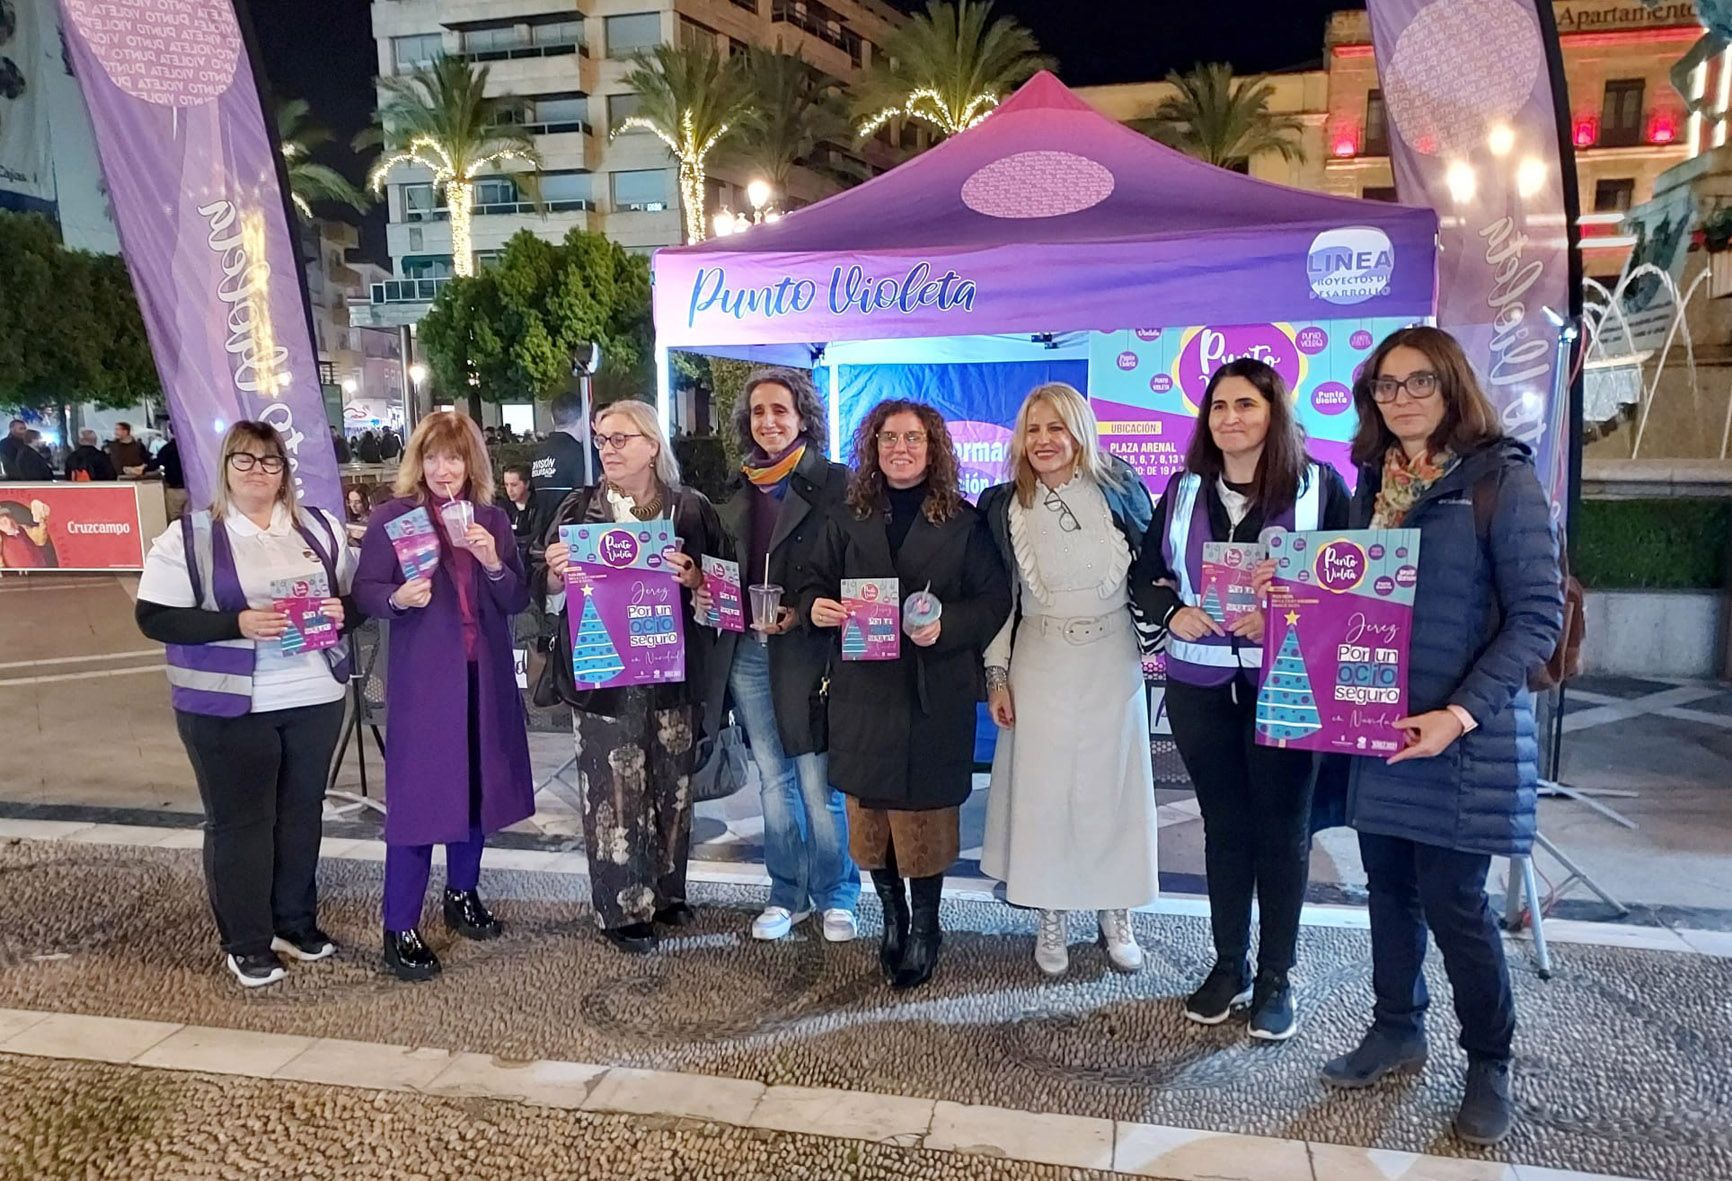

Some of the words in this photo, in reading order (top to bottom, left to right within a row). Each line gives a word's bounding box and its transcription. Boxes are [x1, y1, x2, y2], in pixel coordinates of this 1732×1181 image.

[1308, 250, 1392, 273] LINEA
[688, 266, 816, 328] Punto
[827, 261, 977, 313] Violeta
[1110, 442, 1138, 453] PLAZA
[1141, 442, 1177, 453] ARENAL
[1146, 466, 1158, 476] DE
[1160, 466, 1170, 476] 19
[67, 521, 131, 535] Cruzcampo
[605, 534, 632, 551] Punto
[1324, 546, 1358, 568] Punto
[1324, 568, 1357, 583] Violeta
[631, 580, 670, 604] Jerez
[628, 606, 651, 618] Por
[655, 605, 672, 616] un
[1346, 612, 1400, 643] Jerez
[631, 633, 677, 648] seguro
[1338, 645, 1370, 661] Por
[1375, 648, 1398, 663] un
[1335, 686, 1400, 705] seguro
